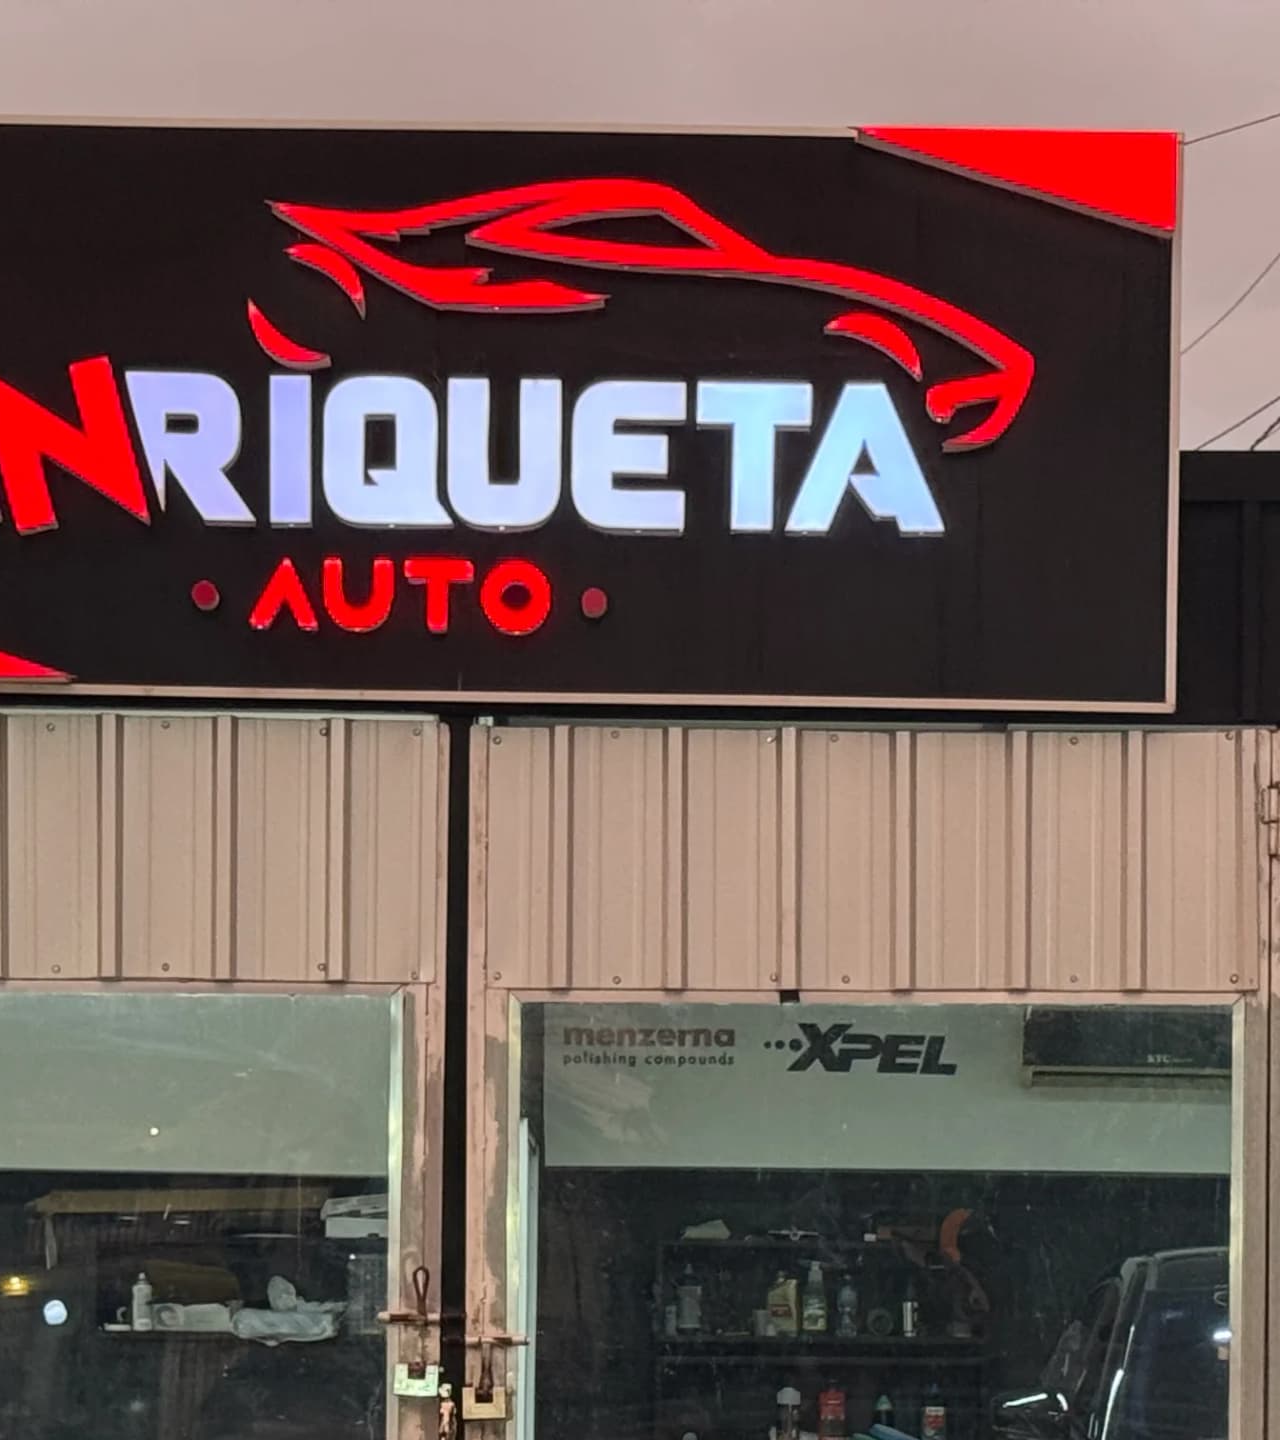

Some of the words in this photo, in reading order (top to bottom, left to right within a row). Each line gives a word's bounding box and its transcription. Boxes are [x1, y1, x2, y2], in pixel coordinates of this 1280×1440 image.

[249, 556, 553, 637] AUTO
[562, 1025, 736, 1048] menzerna
[787, 1022, 958, 1076] XPEL
[562, 1051, 637, 1067] polishing
[644, 1052, 736, 1067] compounds
